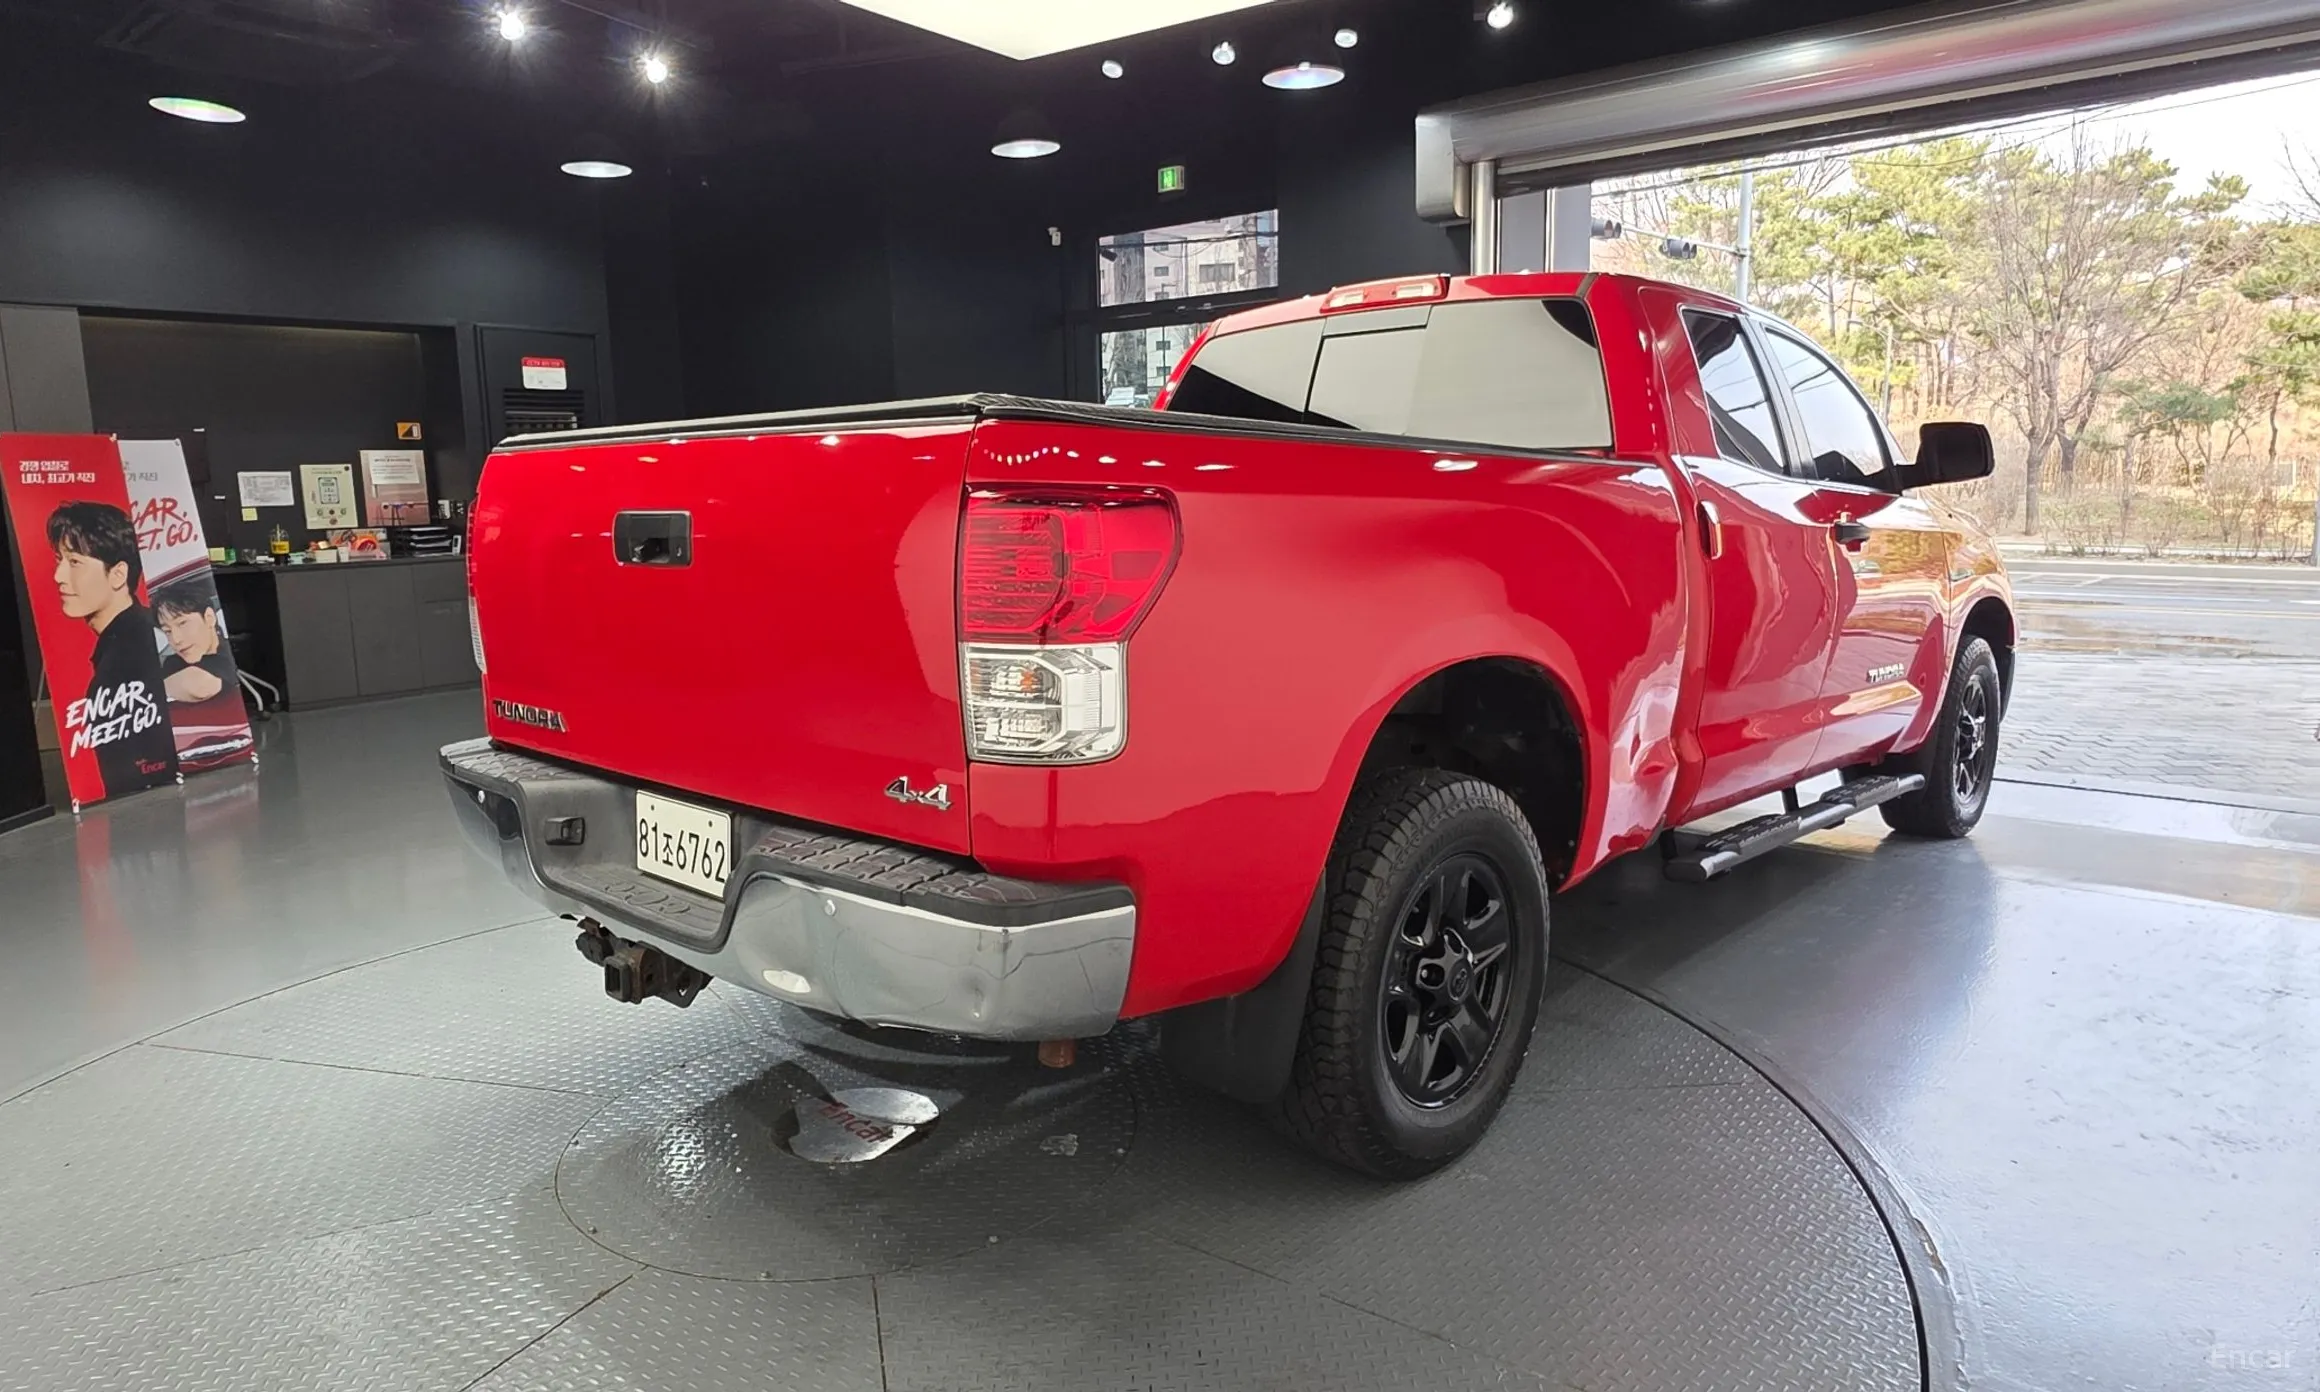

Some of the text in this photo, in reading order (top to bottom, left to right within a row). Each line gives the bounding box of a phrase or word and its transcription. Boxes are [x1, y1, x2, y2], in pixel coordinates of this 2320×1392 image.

[130, 498, 187, 529] CAR.
[136, 520, 198, 551] ET. GO.
[65, 680, 153, 729] ENCAR.
[493, 698, 568, 733] TUNDRA
[70, 702, 163, 758] MEET. GO.
[885, 775, 952, 811] 4x4
[638, 818, 726, 884] 81조6762
